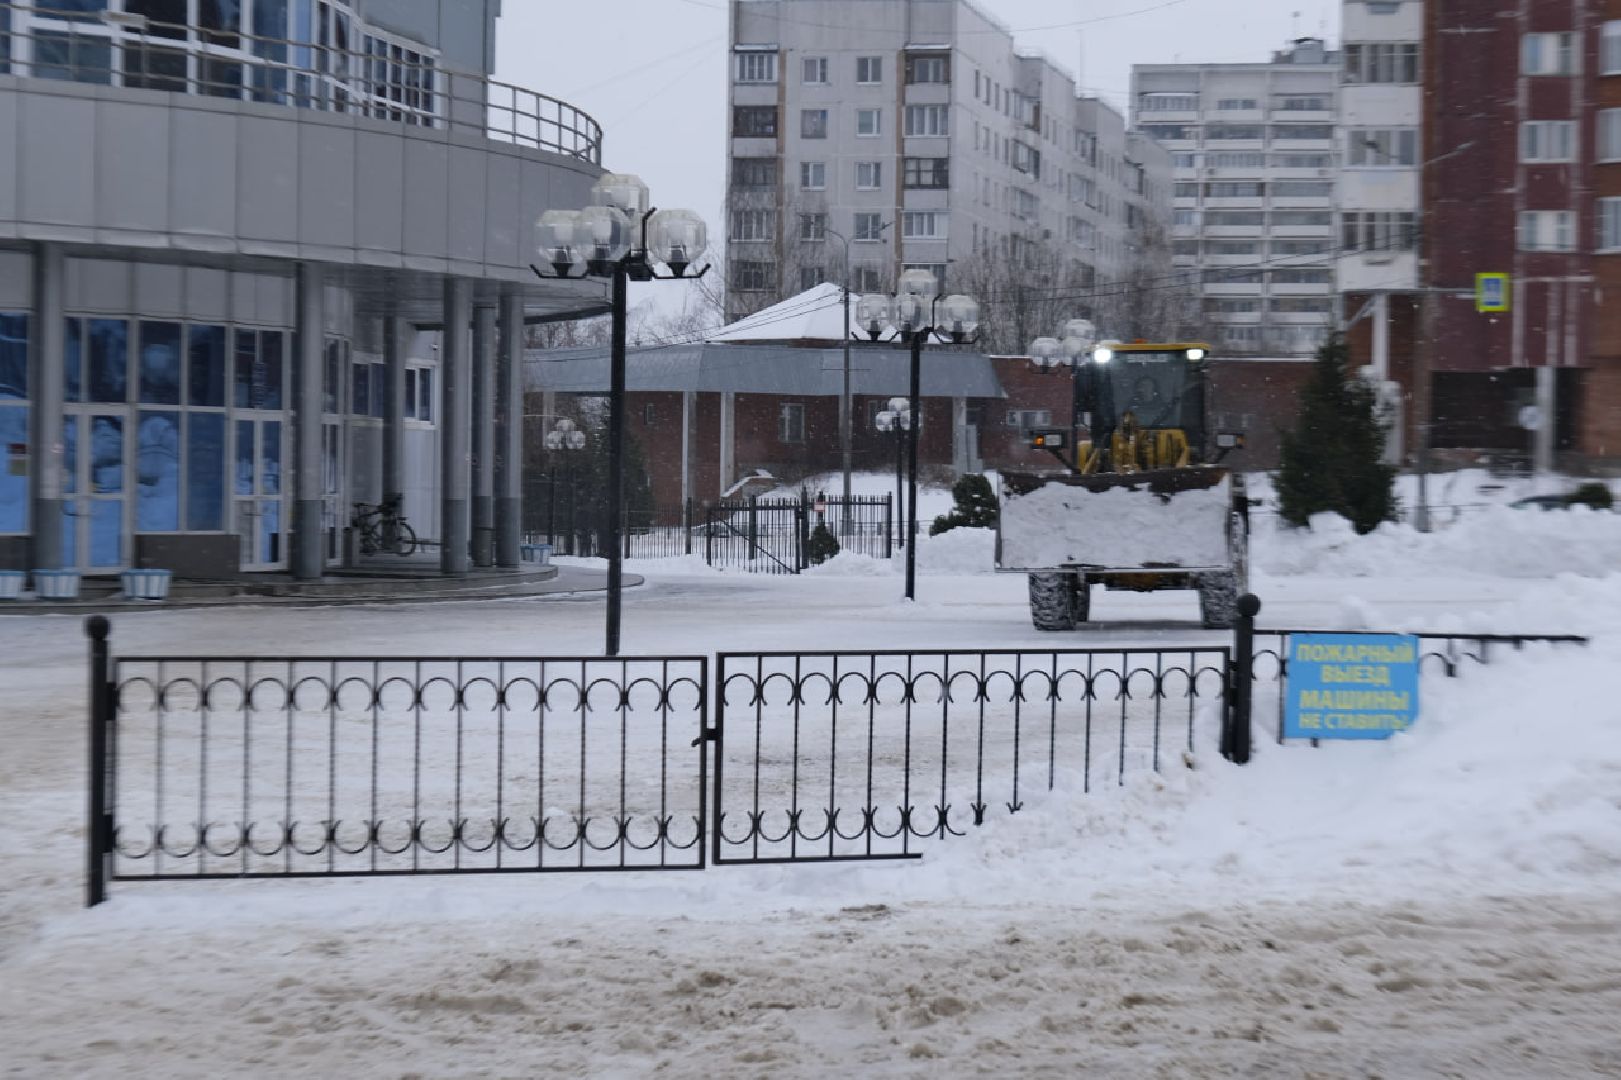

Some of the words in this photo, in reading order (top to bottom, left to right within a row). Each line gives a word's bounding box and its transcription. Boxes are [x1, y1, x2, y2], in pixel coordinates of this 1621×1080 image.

[1297, 643, 1413, 662] ПОЖАРНЫЙ
[1321, 665, 1390, 686] ВЫЕЗД
[1300, 691, 1409, 710] МАШИНЫ
[1299, 713, 1321, 729] НЕ
